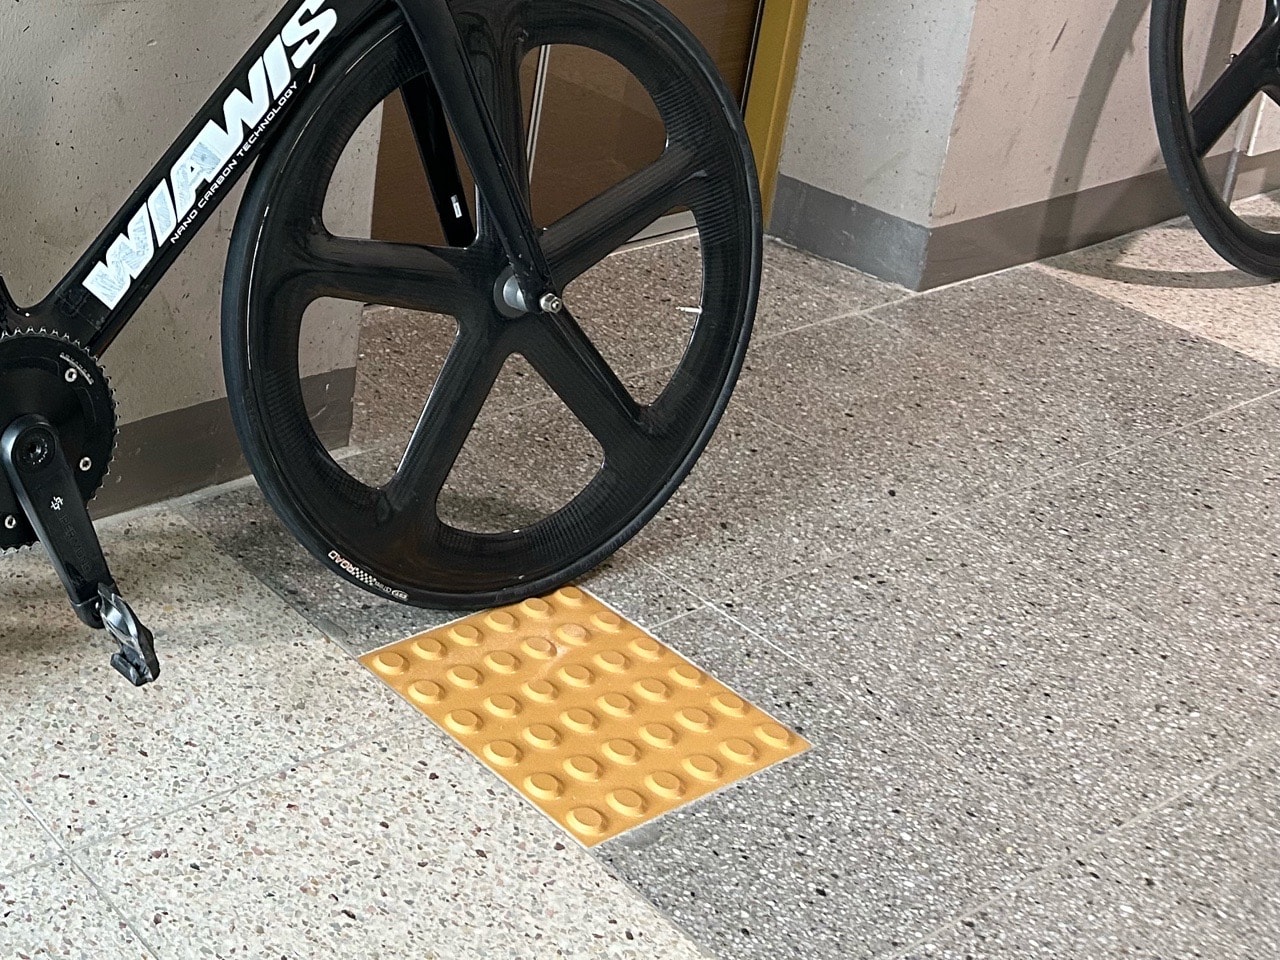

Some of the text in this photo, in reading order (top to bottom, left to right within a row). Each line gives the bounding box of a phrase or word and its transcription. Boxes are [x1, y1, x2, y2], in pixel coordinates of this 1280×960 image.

[170, 79, 299, 244] NANO CARBON TECHNOLOGY
[327, 549, 357, 576] ROAD
